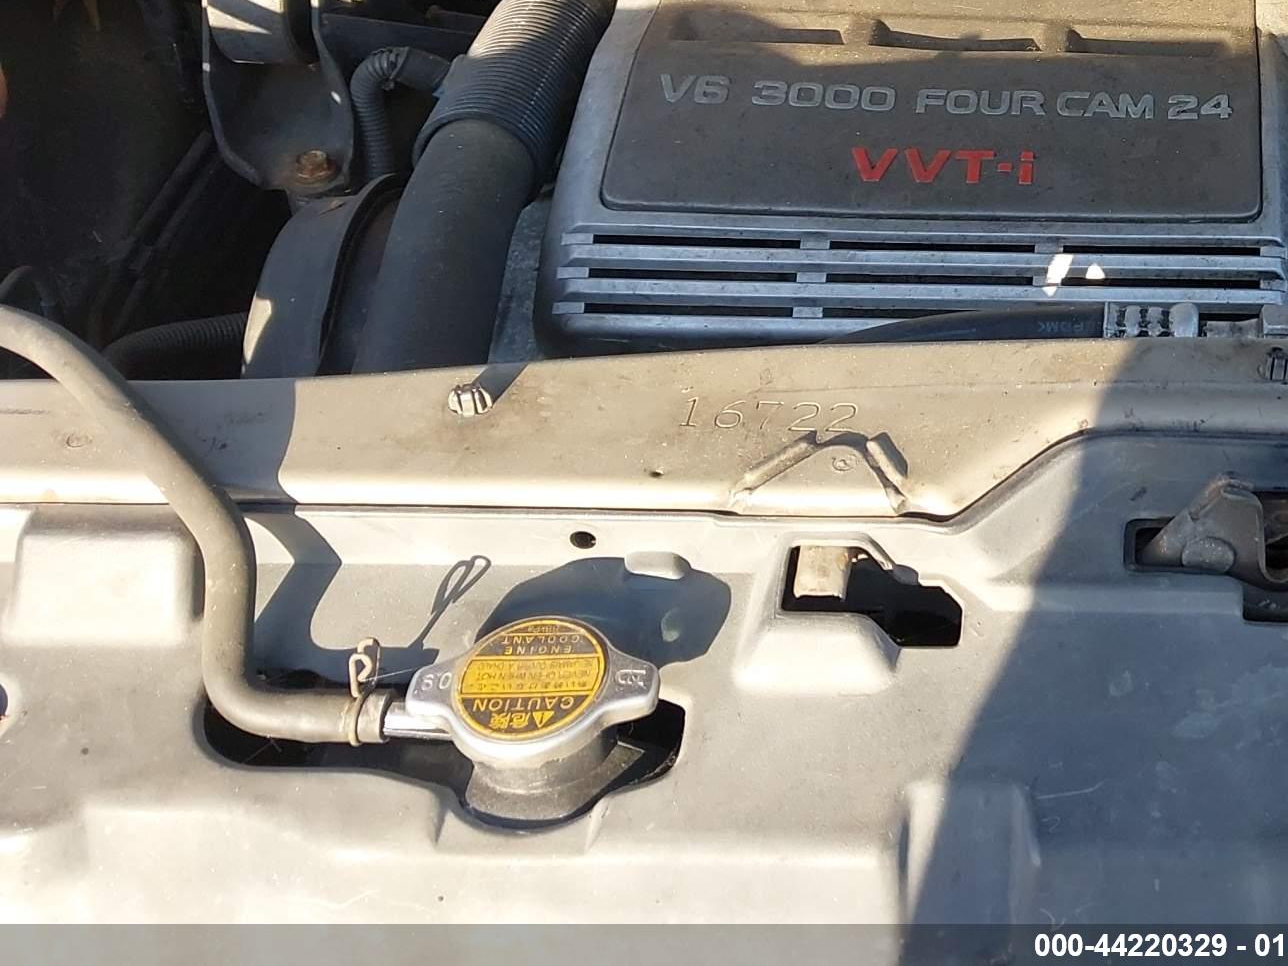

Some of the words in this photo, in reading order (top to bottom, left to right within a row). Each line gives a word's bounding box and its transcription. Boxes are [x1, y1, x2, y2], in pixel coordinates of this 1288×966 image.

[659, 73, 729, 105] V6
[751, 79, 896, 113] 3000
[915, 89, 1045, 117] FOUR
[1056, 92, 1155, 119] CAM
[1167, 93, 1233, 119] 24
[852, 147, 1035, 185] VVT-i
[680, 396, 860, 433] 16722
[501, 635, 580, 644] COOLANT
[504, 645, 573, 655] ENGINE
[473, 696, 574, 712] CAUTION
